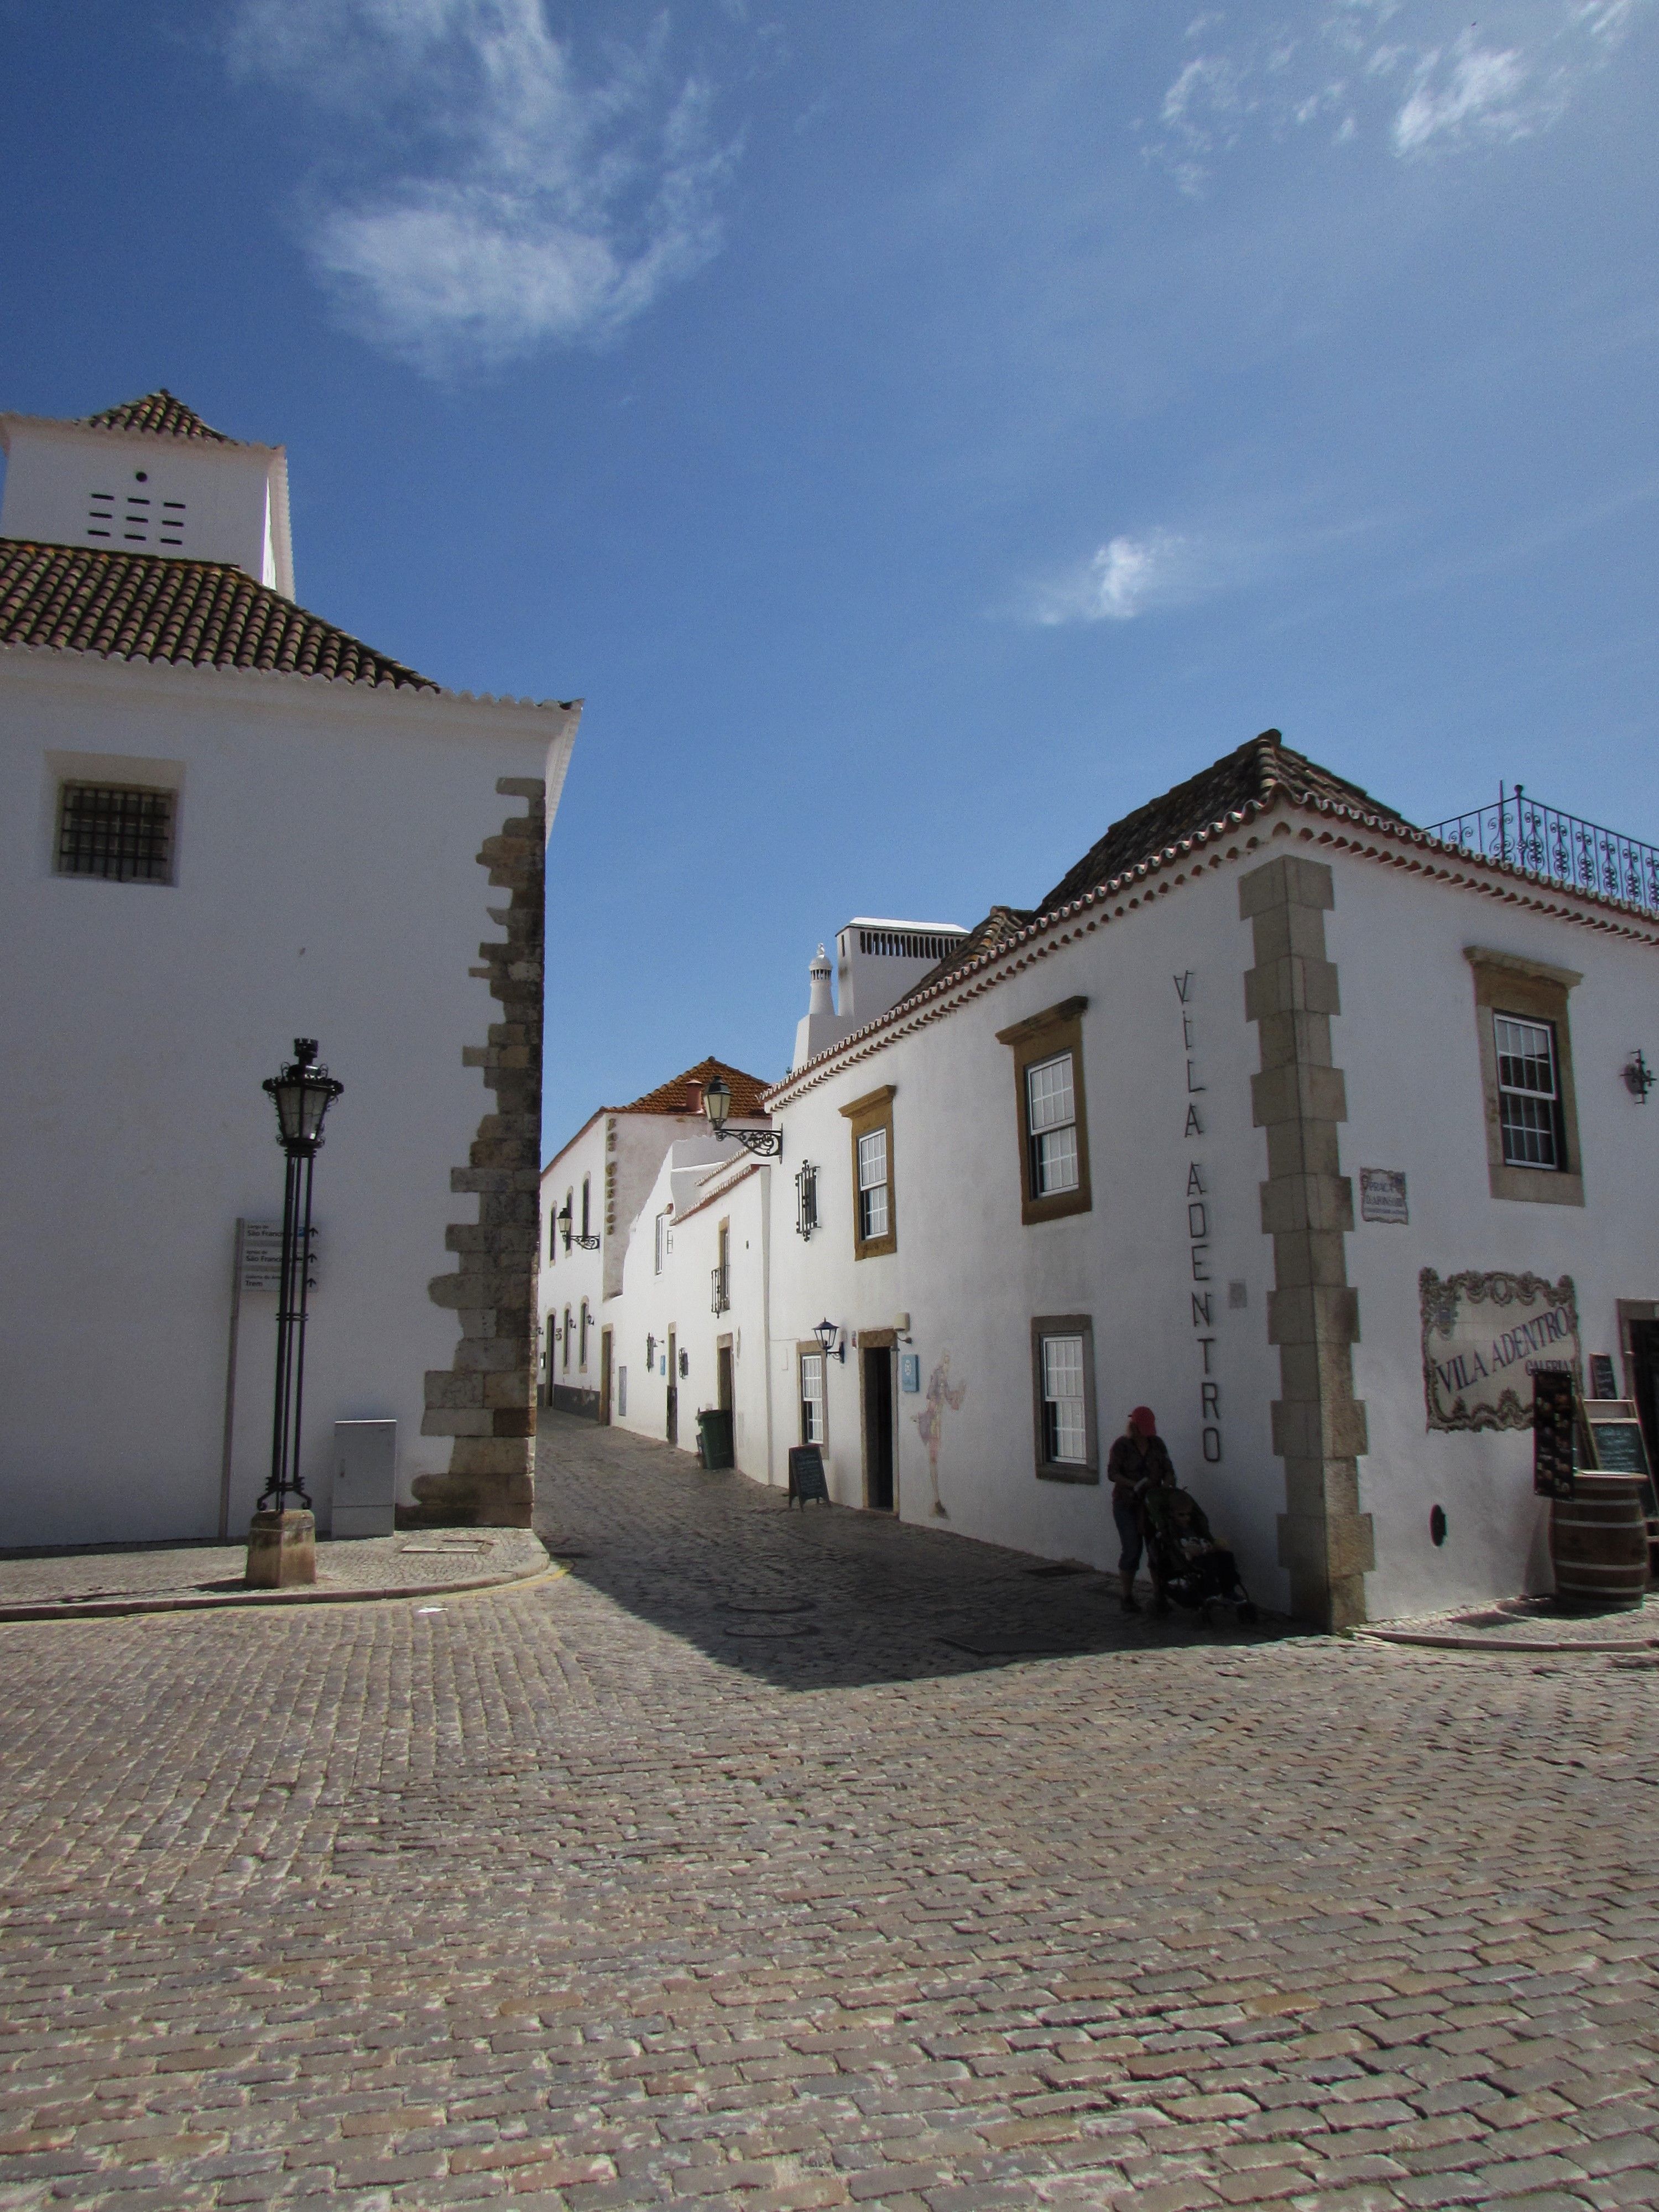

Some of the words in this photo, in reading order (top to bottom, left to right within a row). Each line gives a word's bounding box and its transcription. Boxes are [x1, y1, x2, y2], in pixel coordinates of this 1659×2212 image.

[1187, 1161, 1220, 1463] ADENTRO
[1436, 1349, 1488, 1394] VILA
[1493, 1306, 1569, 1373] ADENTRO
